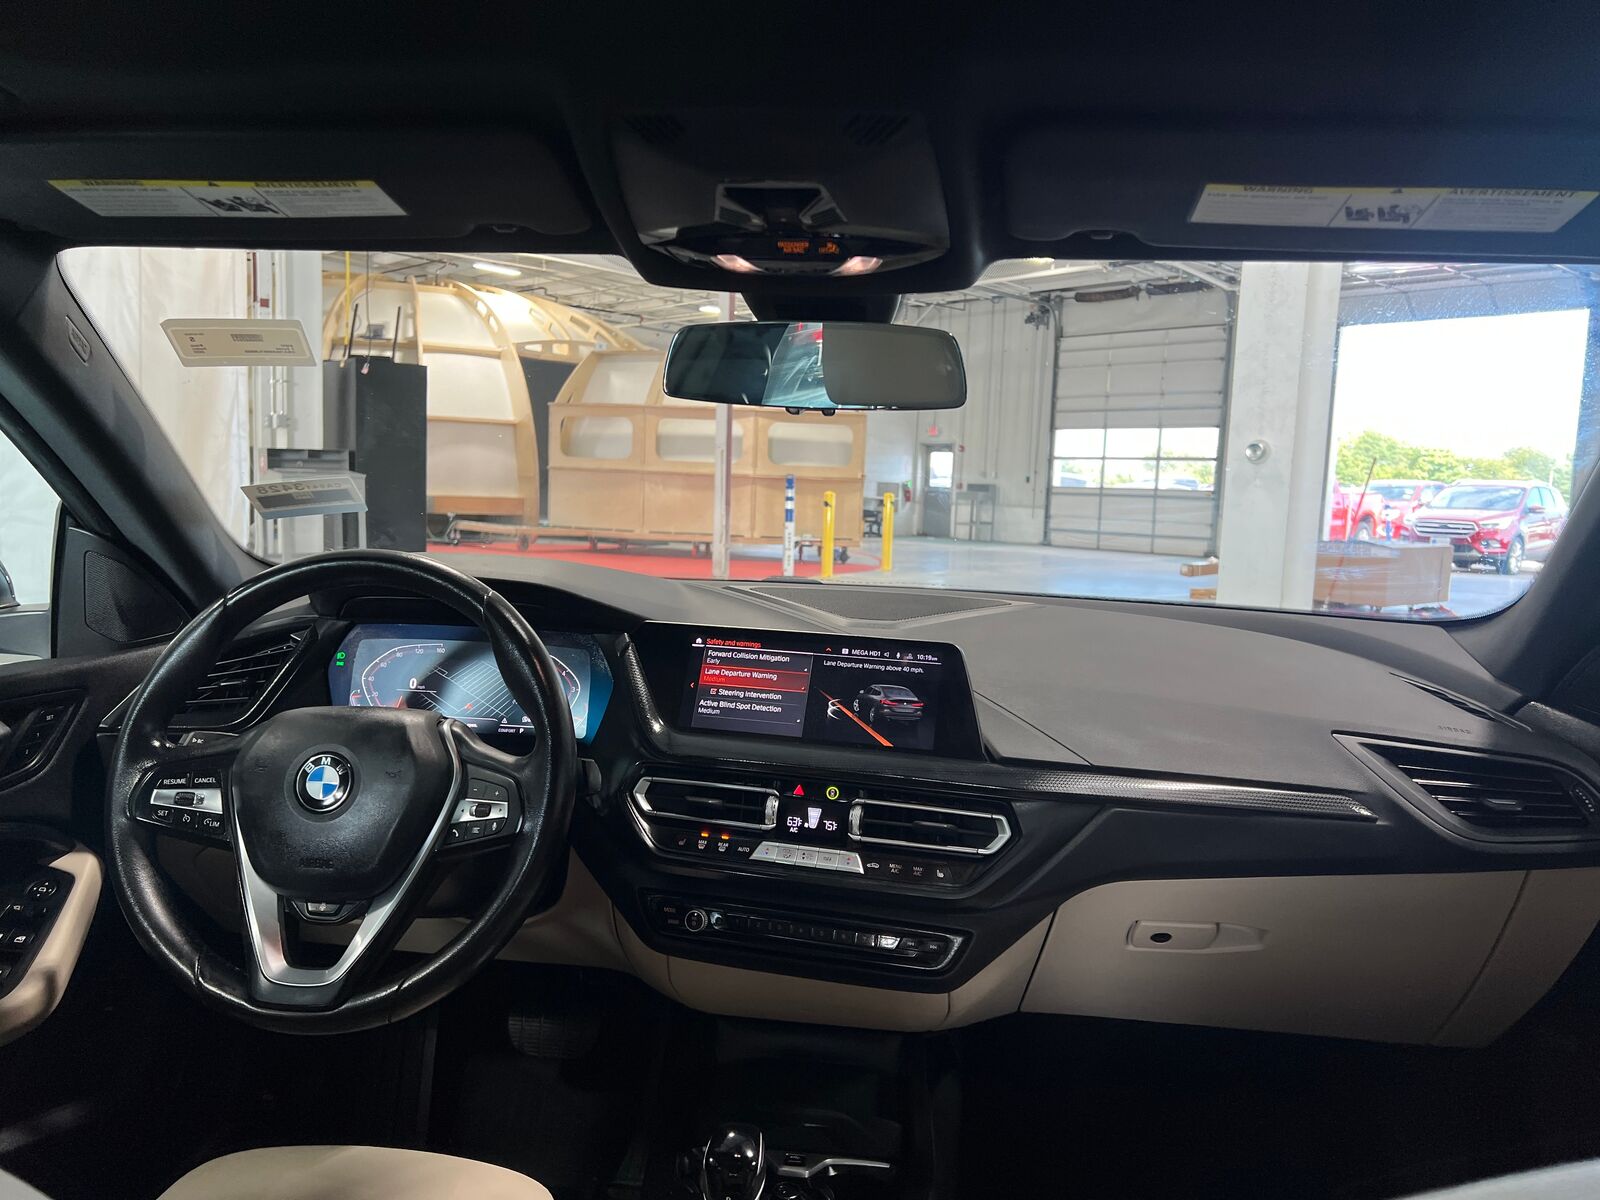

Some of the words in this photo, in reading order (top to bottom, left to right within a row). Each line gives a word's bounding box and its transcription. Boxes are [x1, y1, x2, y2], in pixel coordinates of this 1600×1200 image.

[708, 650, 732, 658] Forward
[732, 652, 758, 660] Collision
[759, 654, 790, 662] Mitigation
[864, 663, 885, 671] Warning
[720, 669, 751, 678] Departure
[752, 671, 778, 680] Warning
[409, 678, 417, 689] 0
[718, 688, 744, 698] Steering
[745, 690, 782, 700] Intervention
[736, 702, 750, 710] Spot
[751, 704, 782, 712] Detection
[304, 756, 347, 776] BMW
